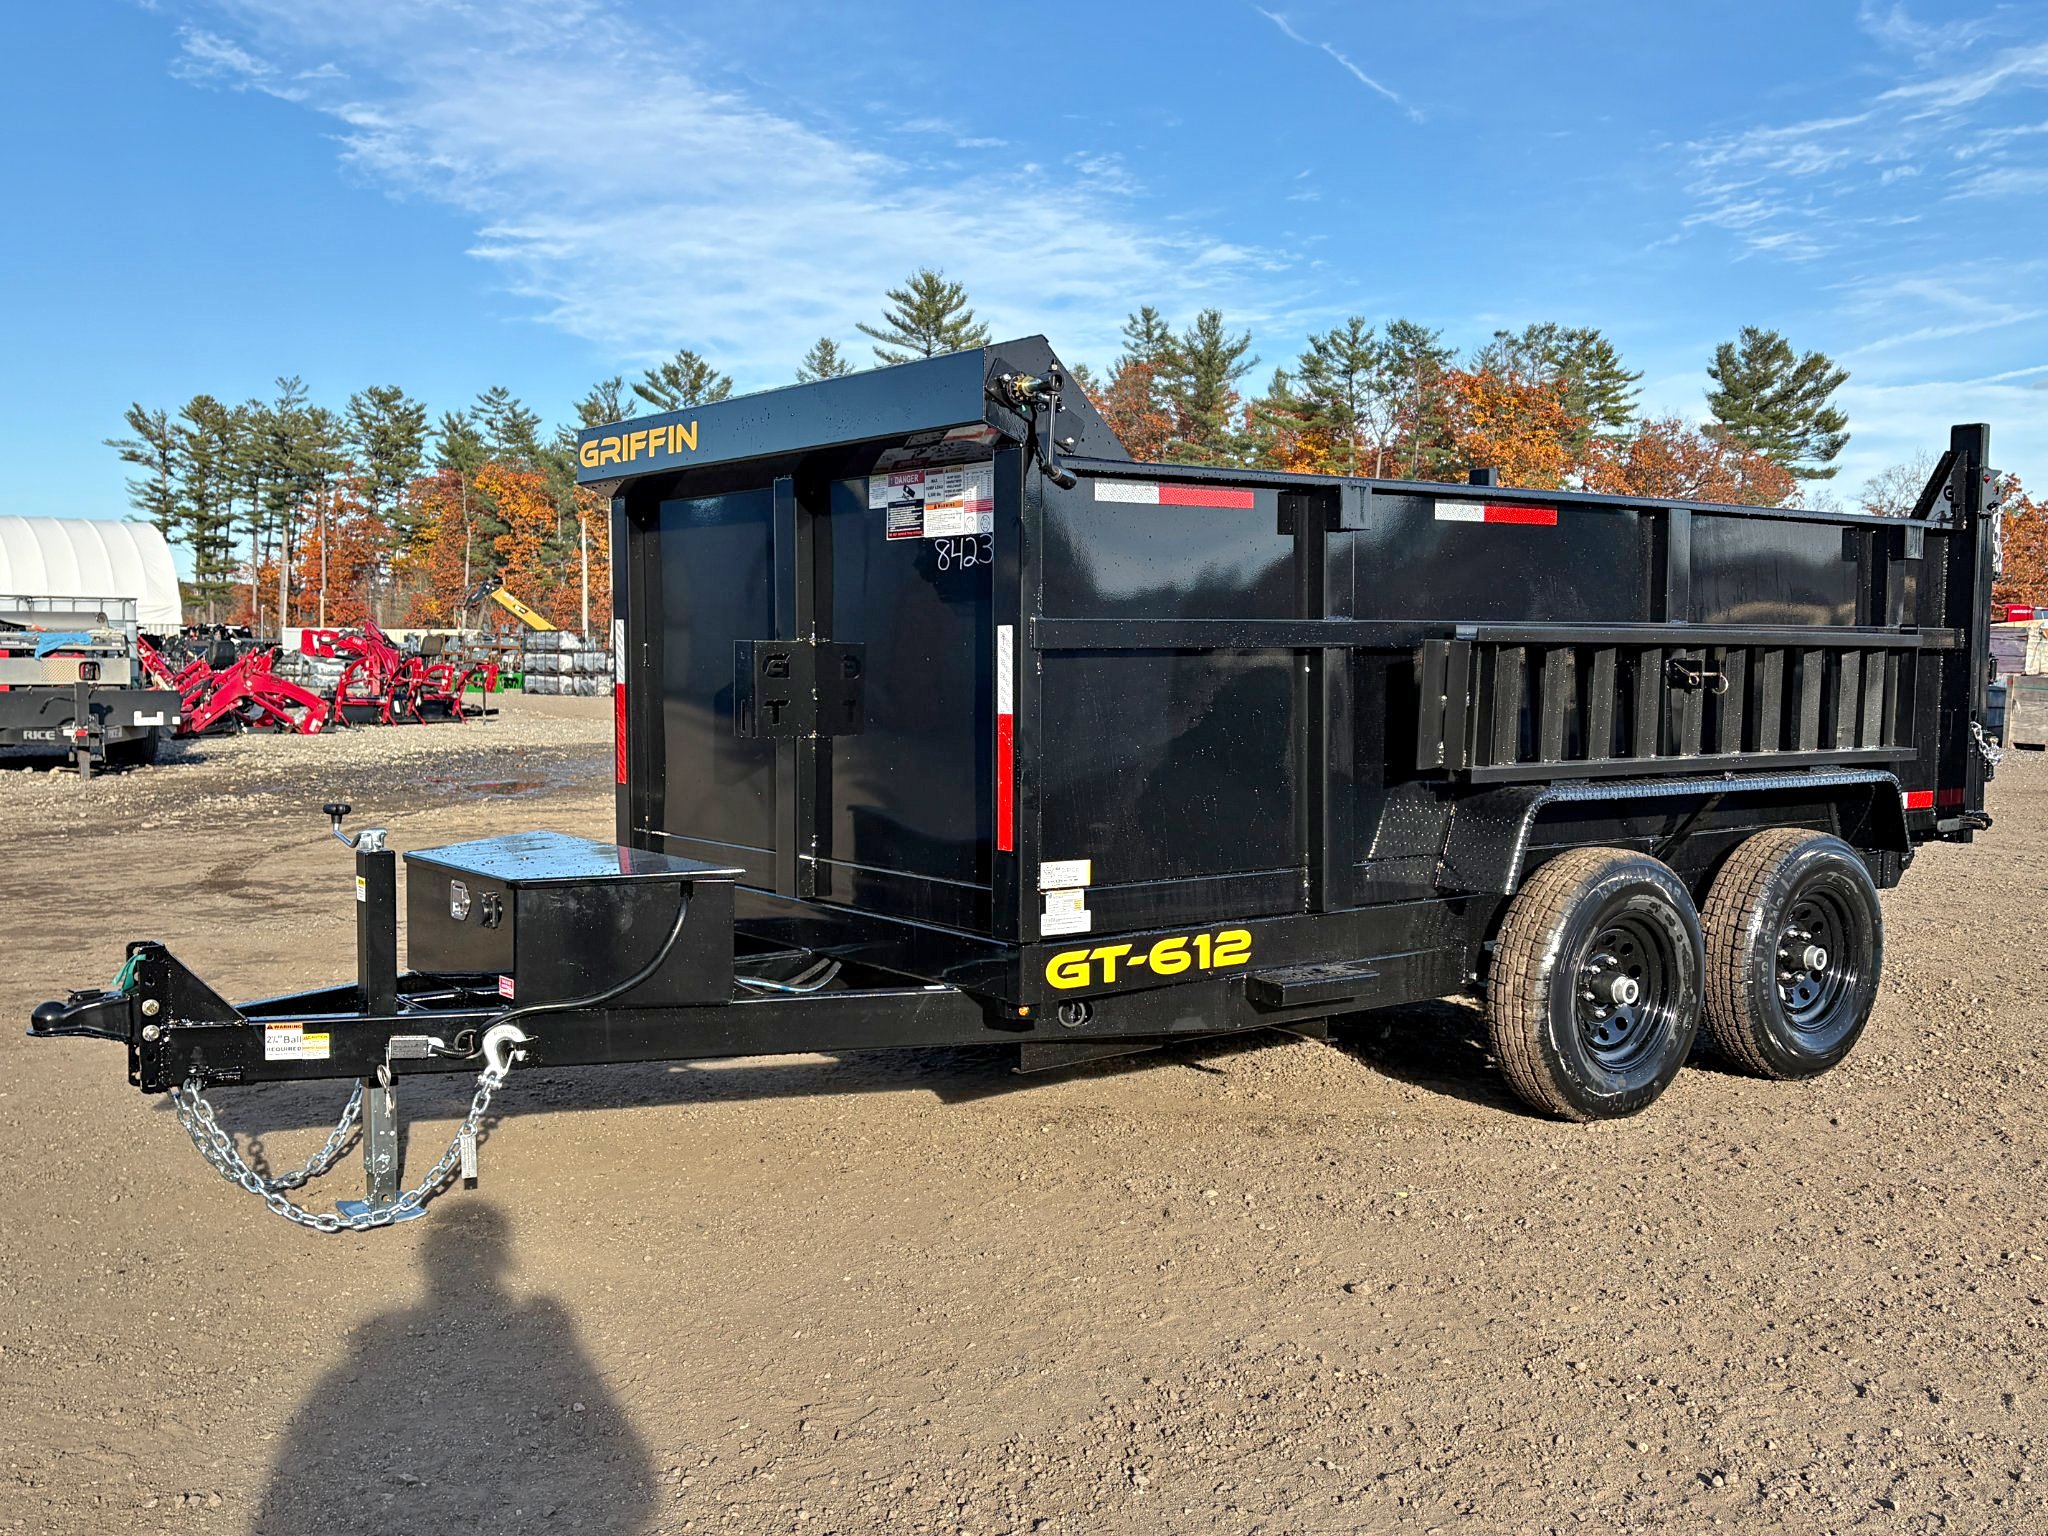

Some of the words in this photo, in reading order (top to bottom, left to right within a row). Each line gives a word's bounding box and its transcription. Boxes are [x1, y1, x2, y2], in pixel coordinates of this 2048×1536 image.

[579, 420, 698, 468] GRIFFIN
[894, 474, 919, 485] DANGER
[934, 533, 994, 571] 8423
[23, 730, 56, 740] RICE
[1045, 929, 1253, 990] GT-612
[283, 1035, 302, 1044] Ball
